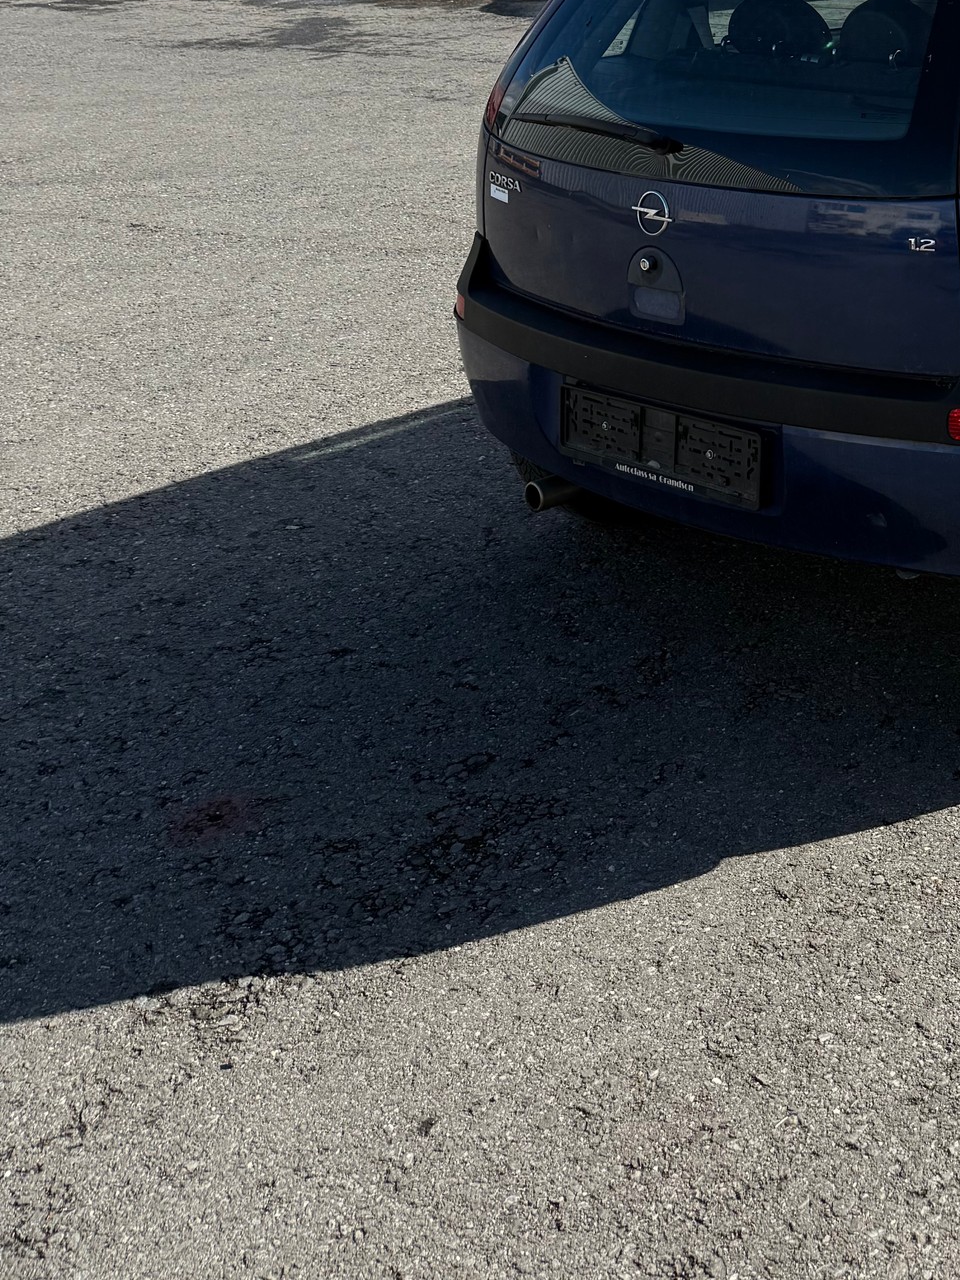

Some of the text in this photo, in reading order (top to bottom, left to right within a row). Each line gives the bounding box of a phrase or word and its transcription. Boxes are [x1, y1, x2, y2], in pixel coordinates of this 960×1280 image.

[489, 171, 521, 193] CORSA
[908, 237, 936, 252] 1.2
[615, 463, 647, 478] Autoclass
[659, 475, 694, 492] Grandson
